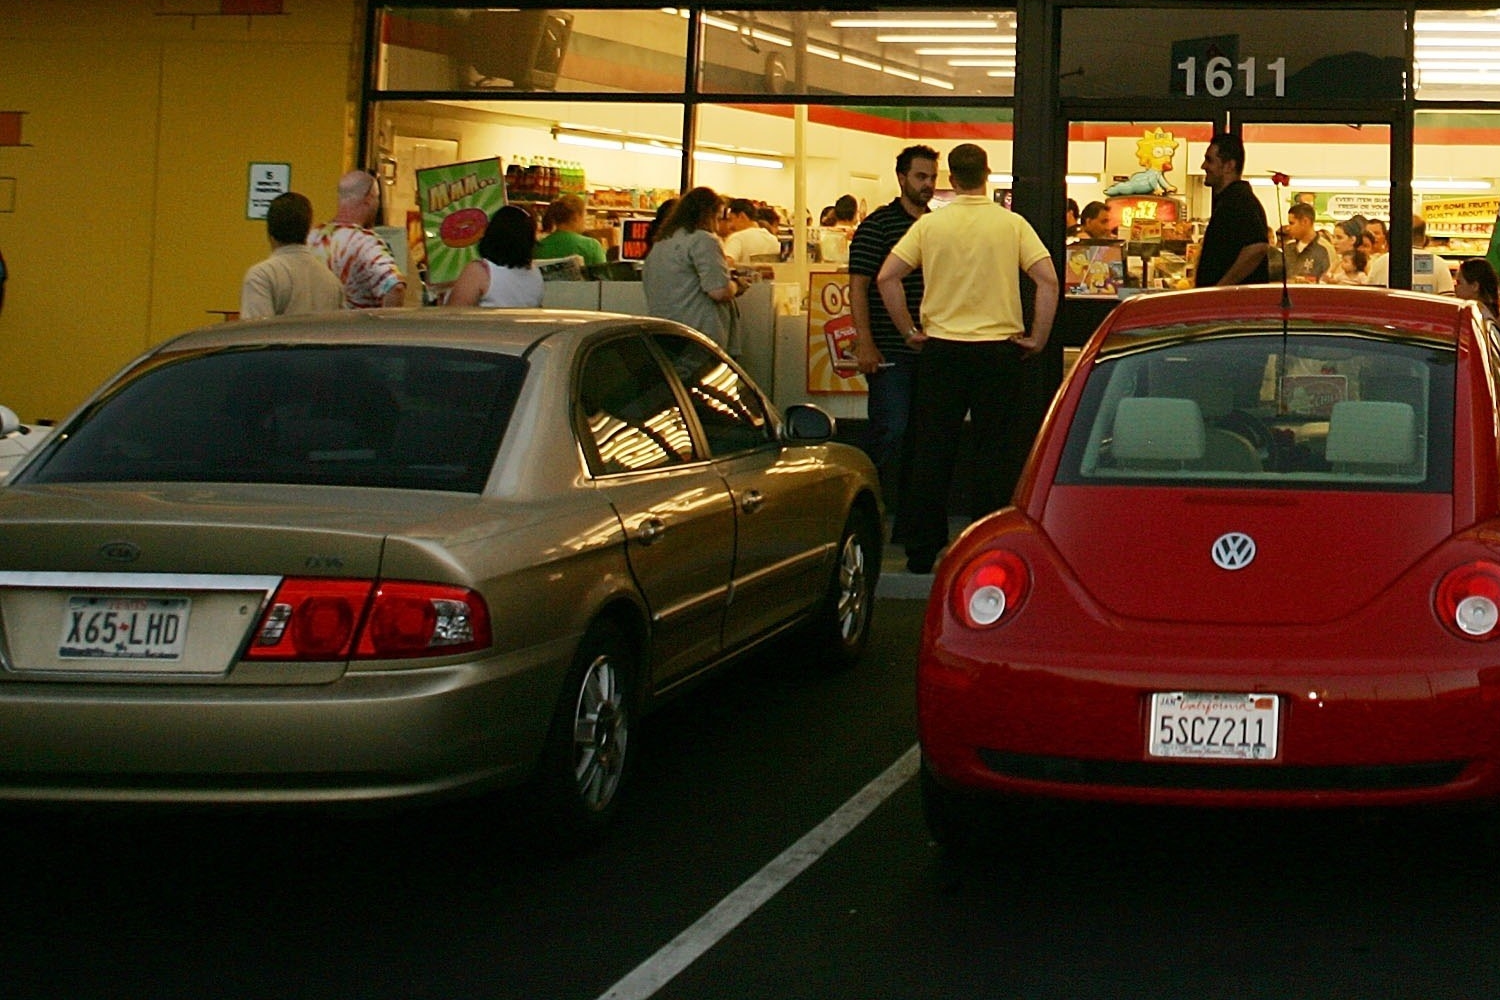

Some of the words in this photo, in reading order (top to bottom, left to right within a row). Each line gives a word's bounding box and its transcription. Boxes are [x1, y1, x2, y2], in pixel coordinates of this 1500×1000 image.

[1177, 56, 1286, 97] 1611
[1425, 204, 1441, 212] BUY
[1443, 202, 1465, 210] SOME
[1468, 201, 1489, 209] FRUIT
[1427, 211, 1453, 219] GUILTY
[1457, 210, 1483, 218] ABOUT
[1178, 698, 1255, 715] California
[1160, 715, 1267, 748] 5SCZ211
